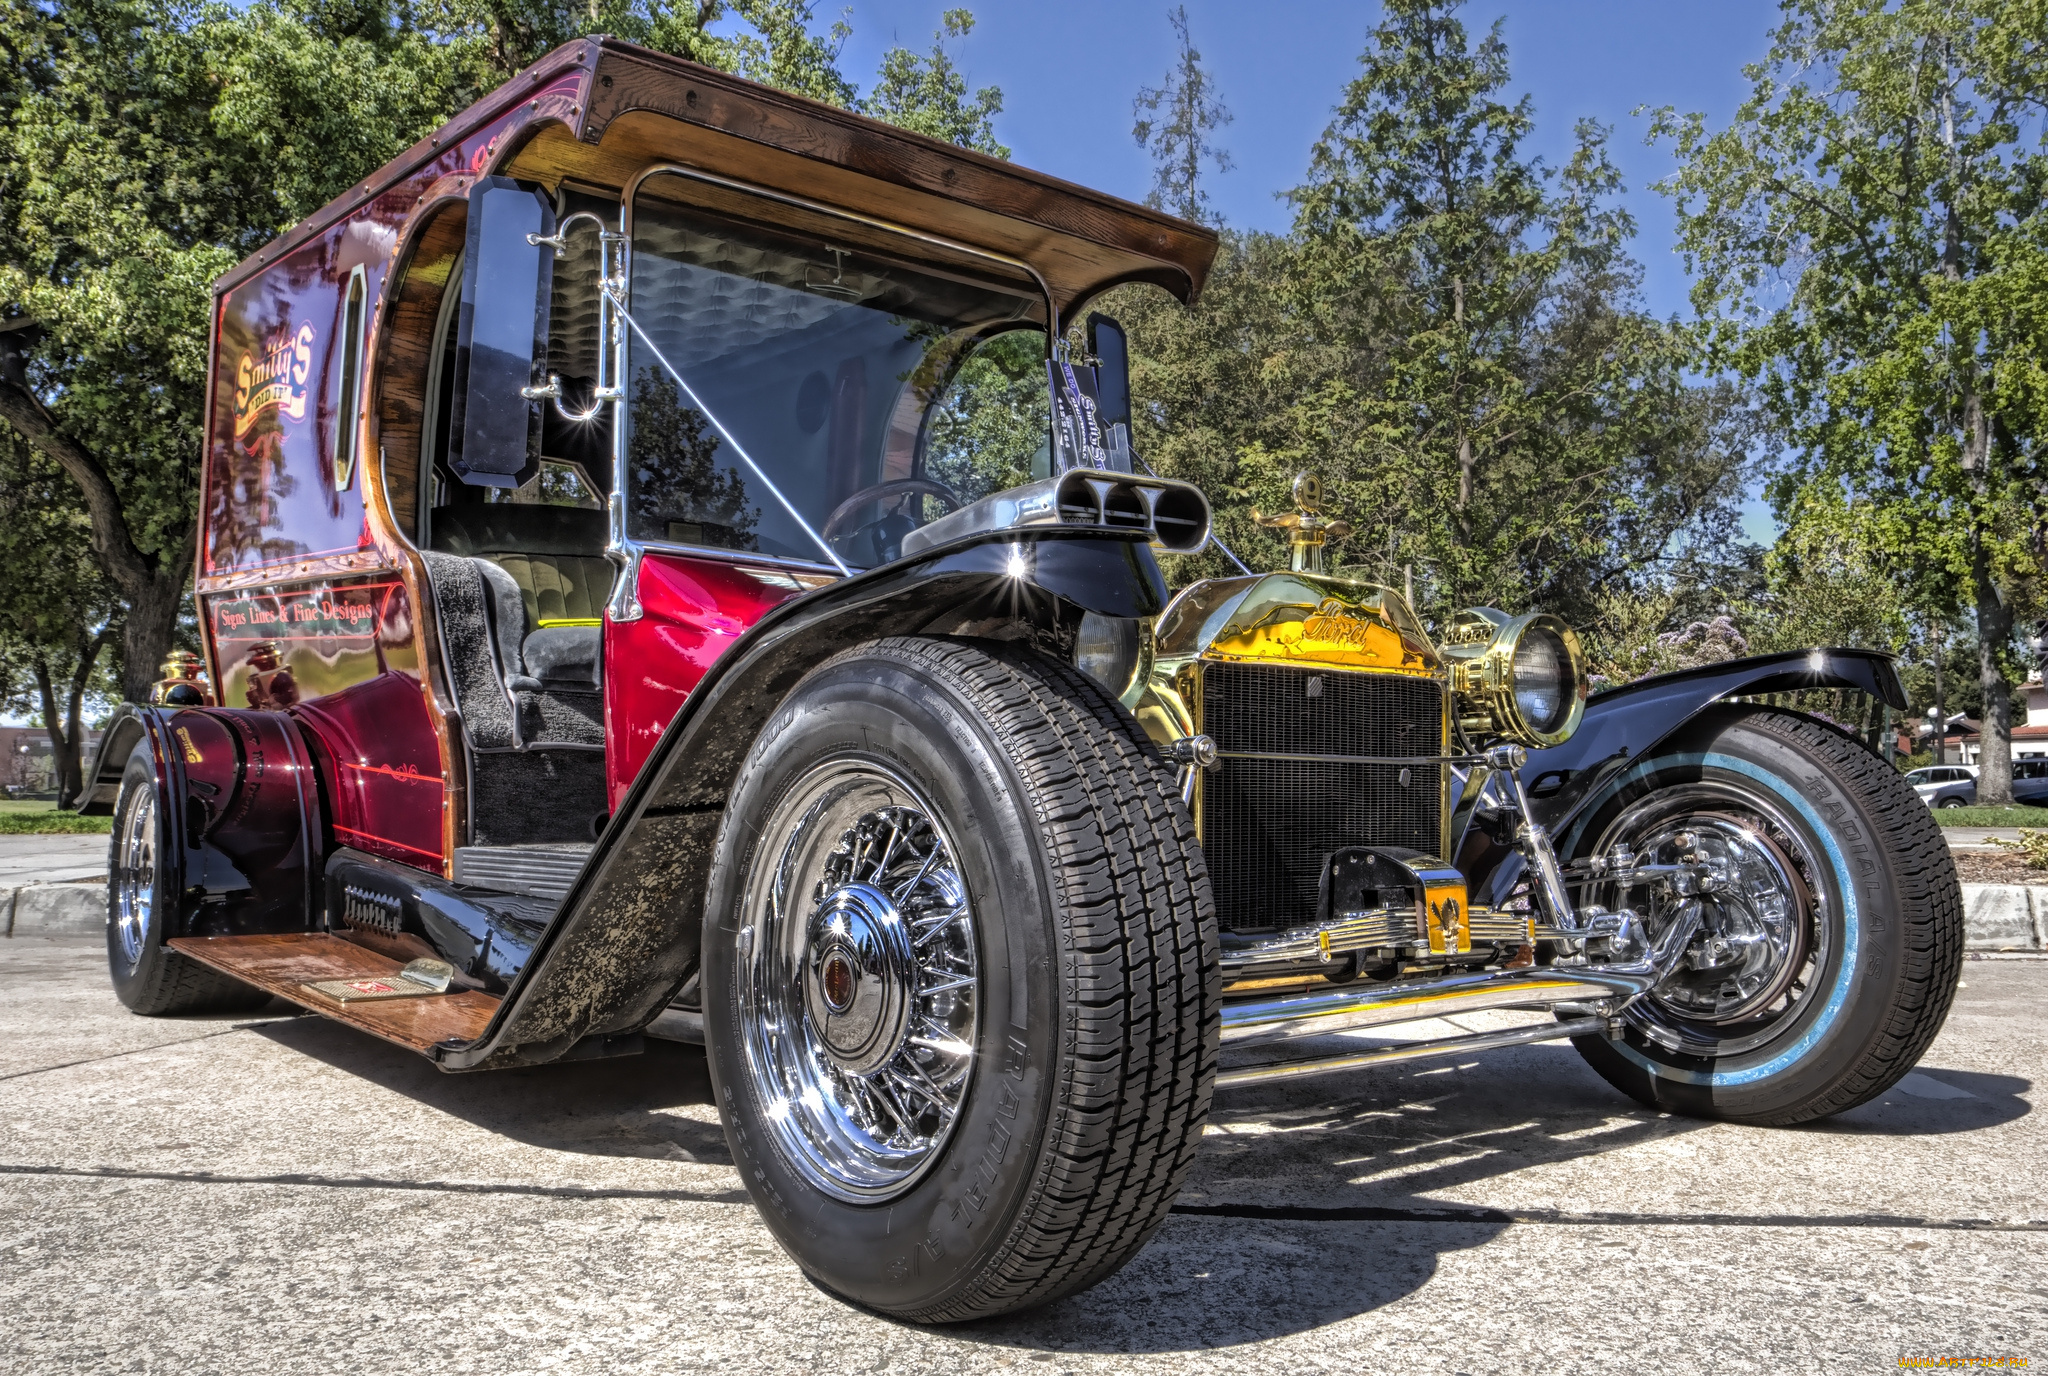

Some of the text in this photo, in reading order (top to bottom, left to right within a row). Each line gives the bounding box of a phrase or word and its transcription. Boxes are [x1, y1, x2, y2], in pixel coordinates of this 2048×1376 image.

[221, 600, 373, 630] Signs Lines & Fine Designs
[1302, 598, 1366, 646] Ford
[1804, 778, 1887, 980] RADIAL A/S
[951, 1035, 1027, 1229] RADIAL
